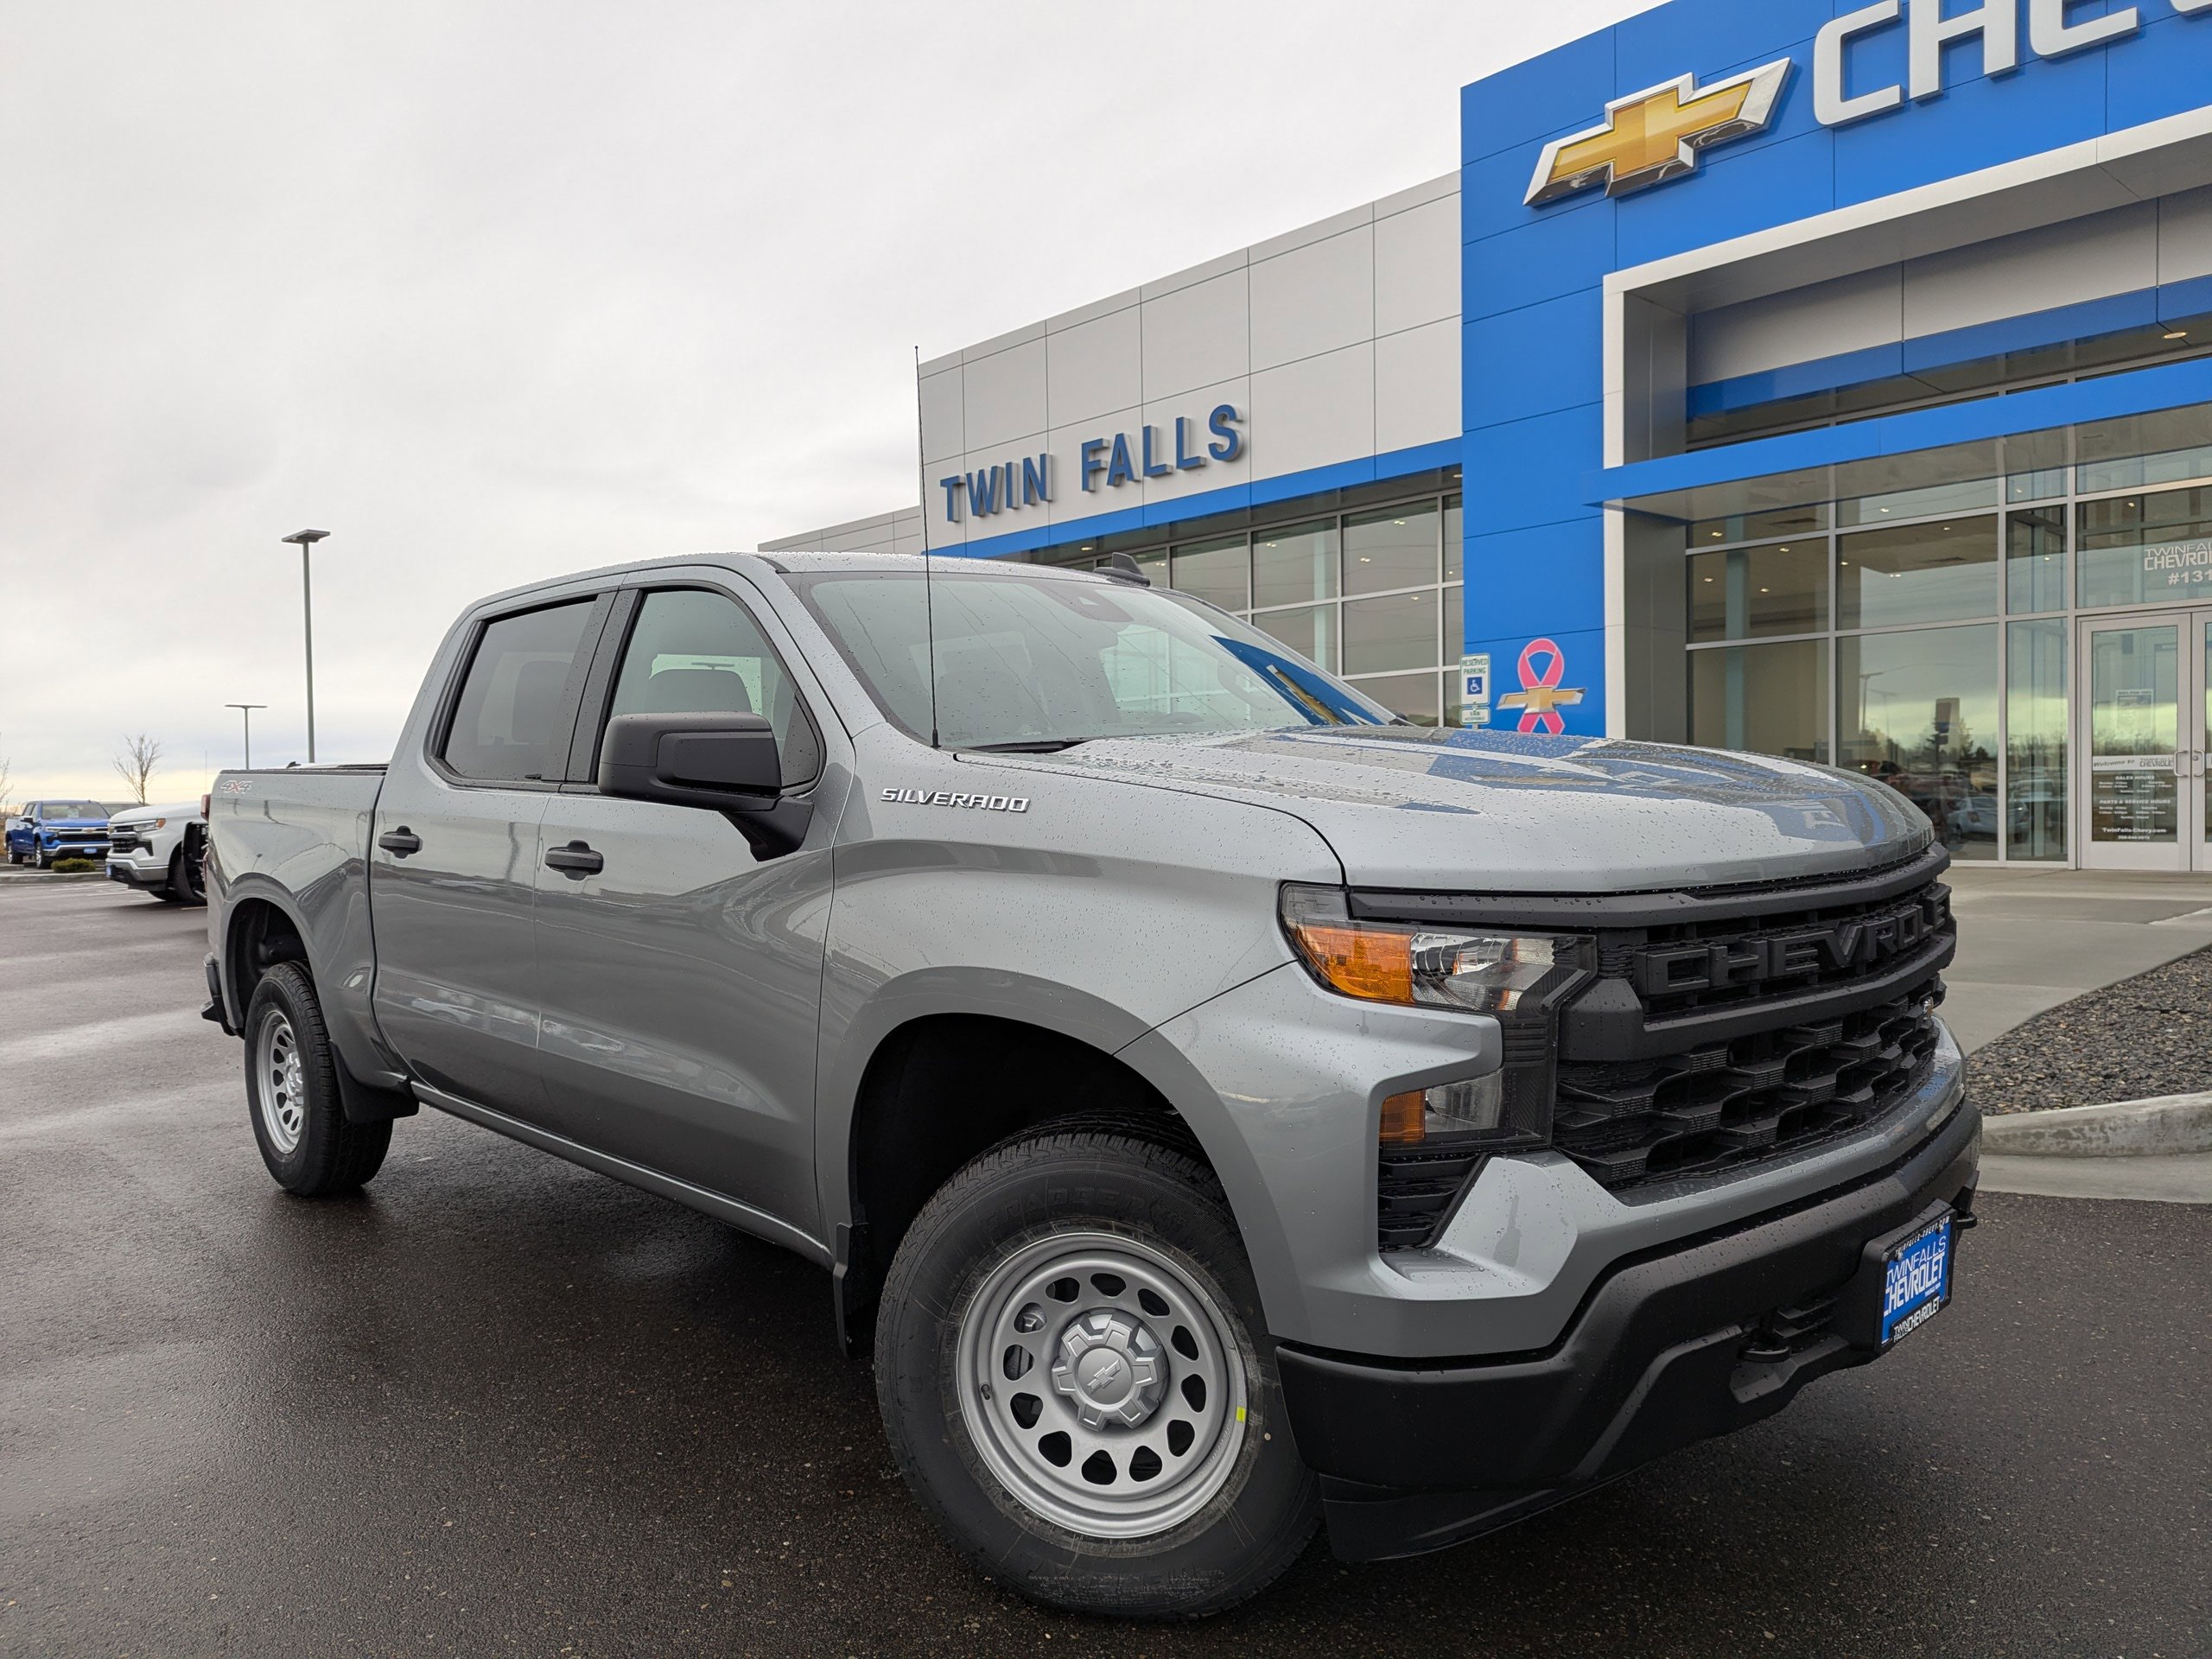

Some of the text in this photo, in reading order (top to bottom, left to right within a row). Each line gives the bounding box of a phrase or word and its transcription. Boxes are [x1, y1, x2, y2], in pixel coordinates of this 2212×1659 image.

[1813, 0, 2212, 129] CHE
[940, 404, 1244, 523] TWIN FALLS
[880, 787, 1031, 813] SILVERADO
